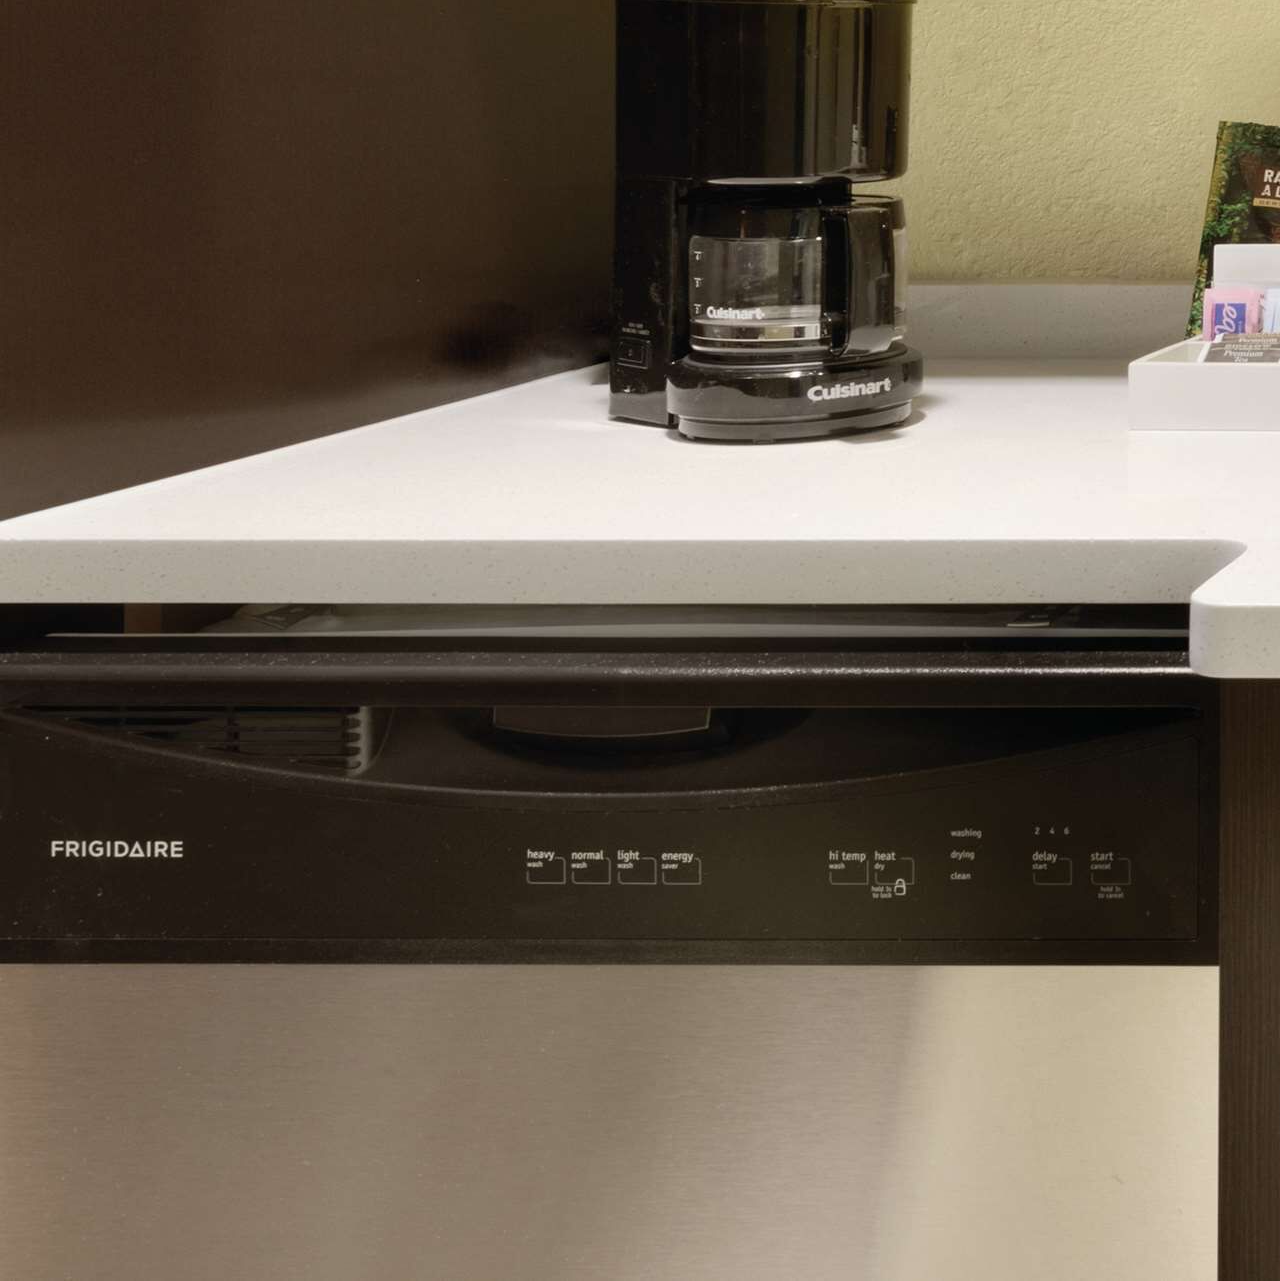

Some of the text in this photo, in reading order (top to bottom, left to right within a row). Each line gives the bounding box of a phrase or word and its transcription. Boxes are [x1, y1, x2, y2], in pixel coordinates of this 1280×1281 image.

[706, 306, 763, 319] Cuisinart
[807, 377, 891, 402] Cuisinart
[950, 828, 982, 838] washing
[51, 840, 183, 857] FRIGIDAIRE
[527, 849, 555, 861] heavy
[571, 849, 604, 860] normal
[617, 850, 640, 862] light
[661, 852, 693, 862] energy
[829, 850, 866, 862] hi temp
[874, 850, 896, 861] heat
[950, 850, 975, 860] drying
[1032, 850, 1057, 864] delay
[1090, 852, 1114, 861] start
[950, 872, 971, 880] clean
